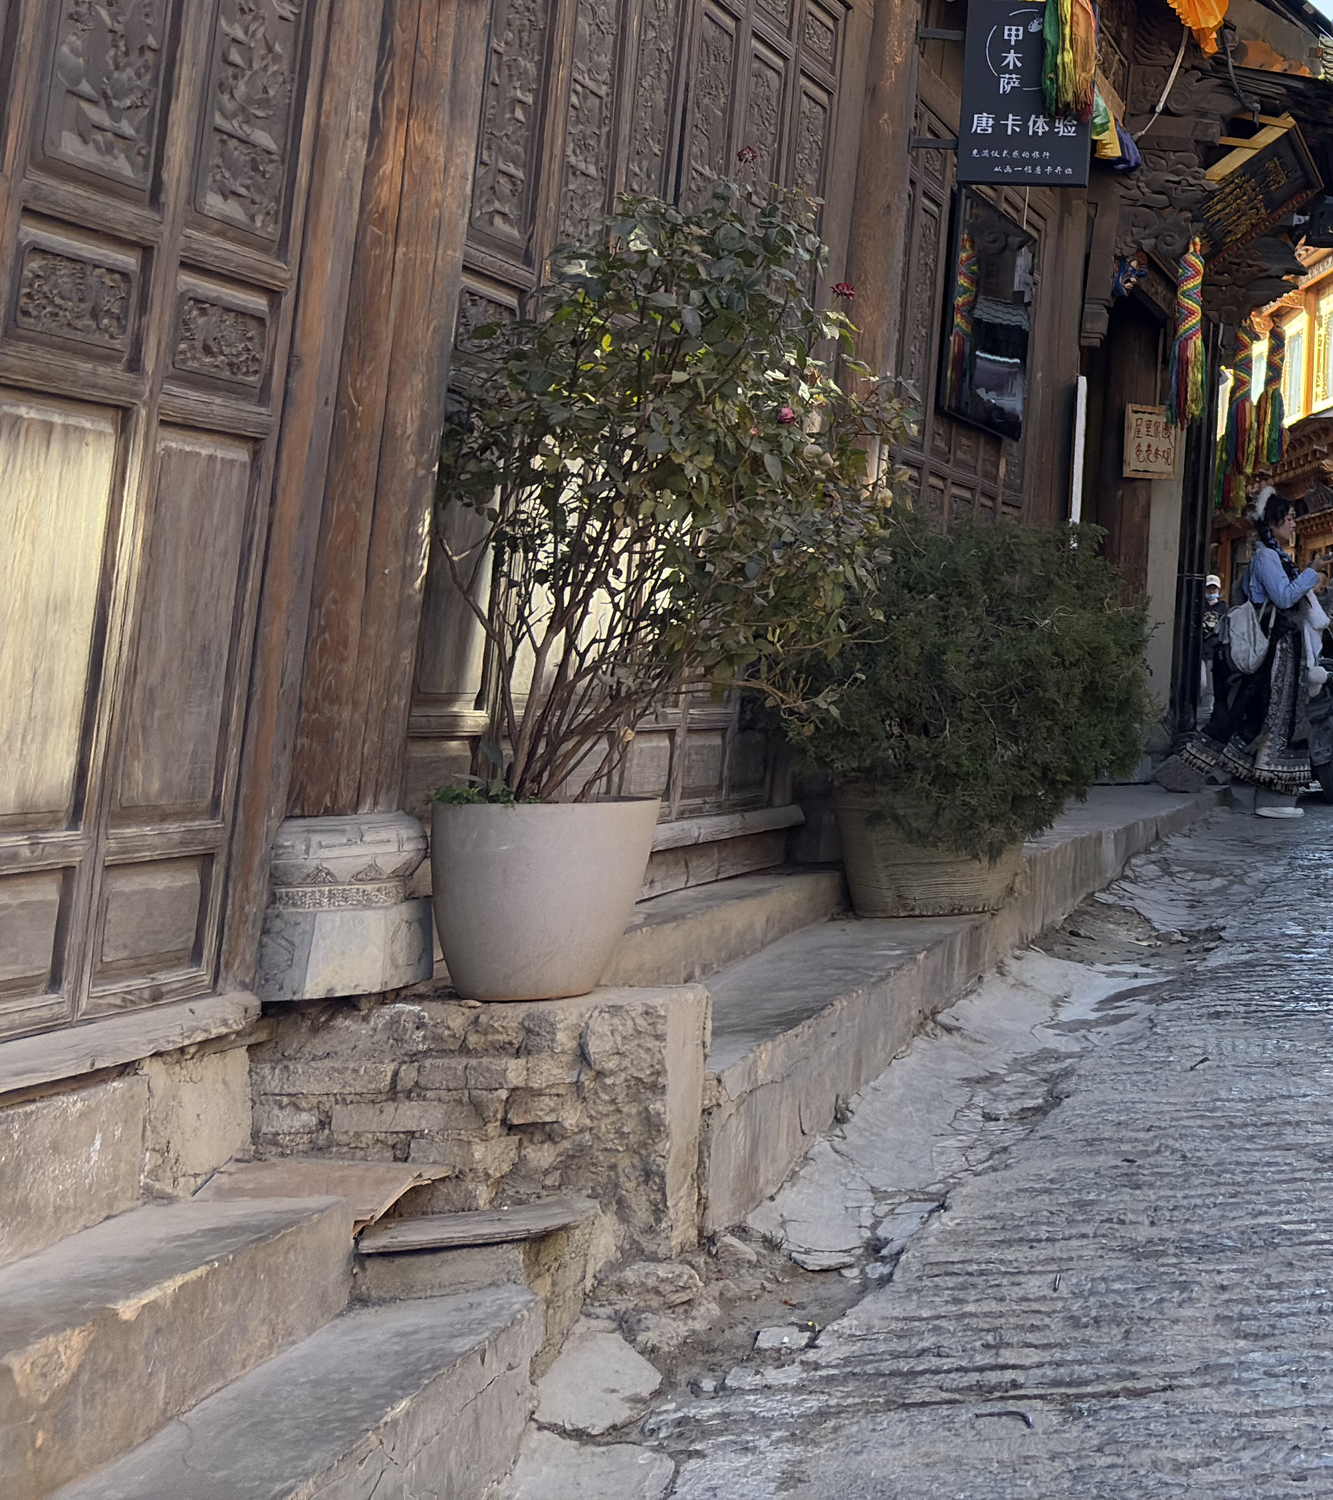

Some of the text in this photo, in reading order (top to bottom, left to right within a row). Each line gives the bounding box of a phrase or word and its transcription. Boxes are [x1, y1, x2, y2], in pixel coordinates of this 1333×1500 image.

[1000, 25, 1024, 94] 甲木萨
[971, 112, 1077, 137] 唐卡体验
